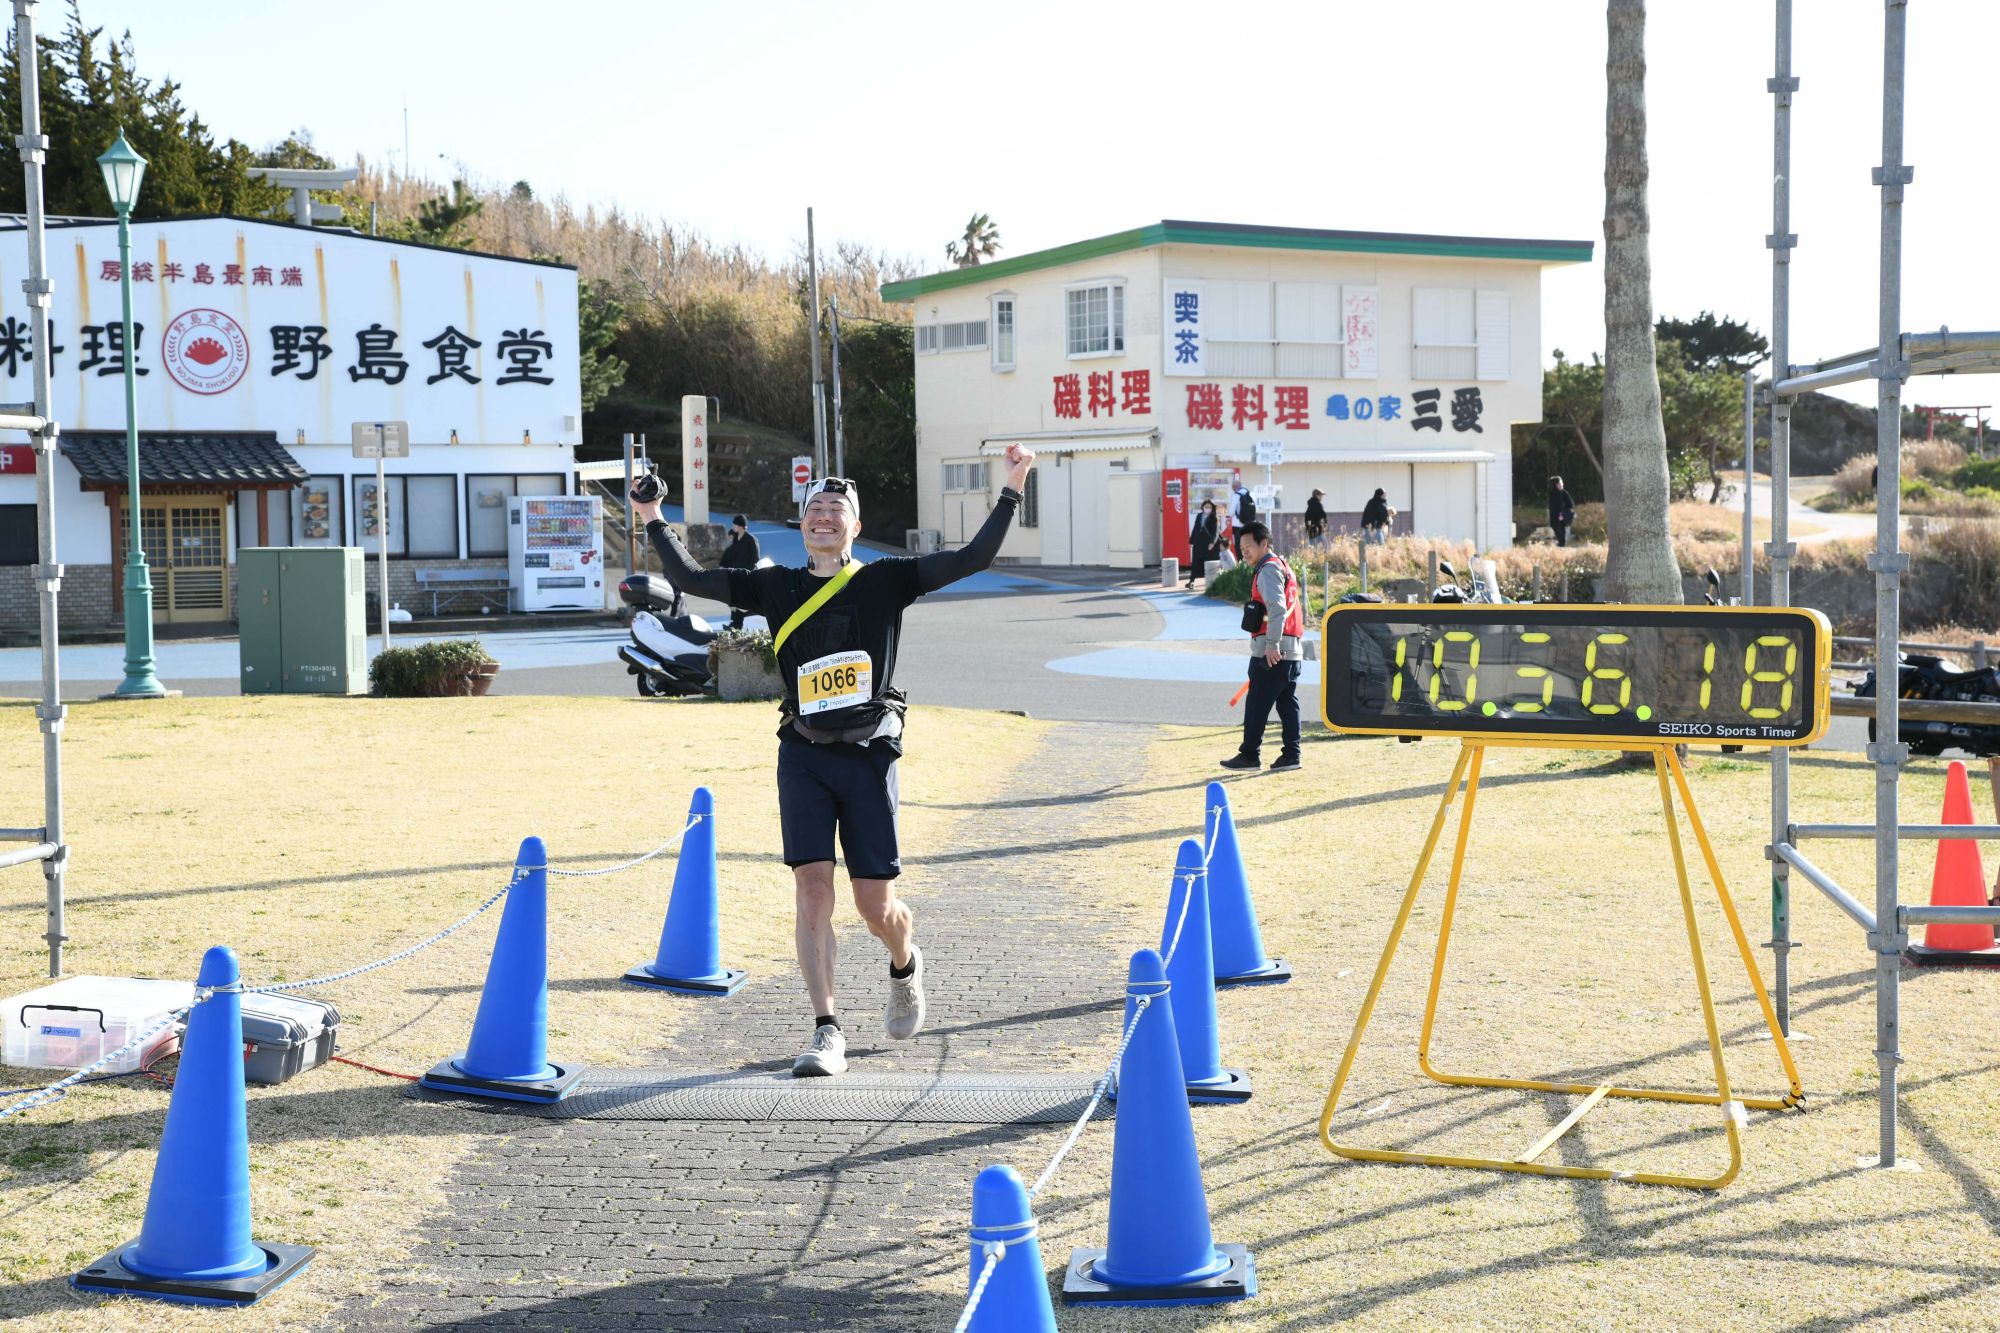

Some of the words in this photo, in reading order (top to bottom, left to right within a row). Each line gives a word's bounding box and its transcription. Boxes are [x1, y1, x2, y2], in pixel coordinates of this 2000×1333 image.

[100, 260, 303, 287] 房総半島最南端
[269, 323, 555, 386] 野島食堂
[1053, 369, 1152, 420] 磯料理
[1185, 383, 1311, 431] 磯料理
[811, 666, 857, 696] 1066
[1658, 722, 1712, 735] SEIKO
[1716, 724, 1757, 737] Sports
[1761, 726, 1797, 738] Timer
